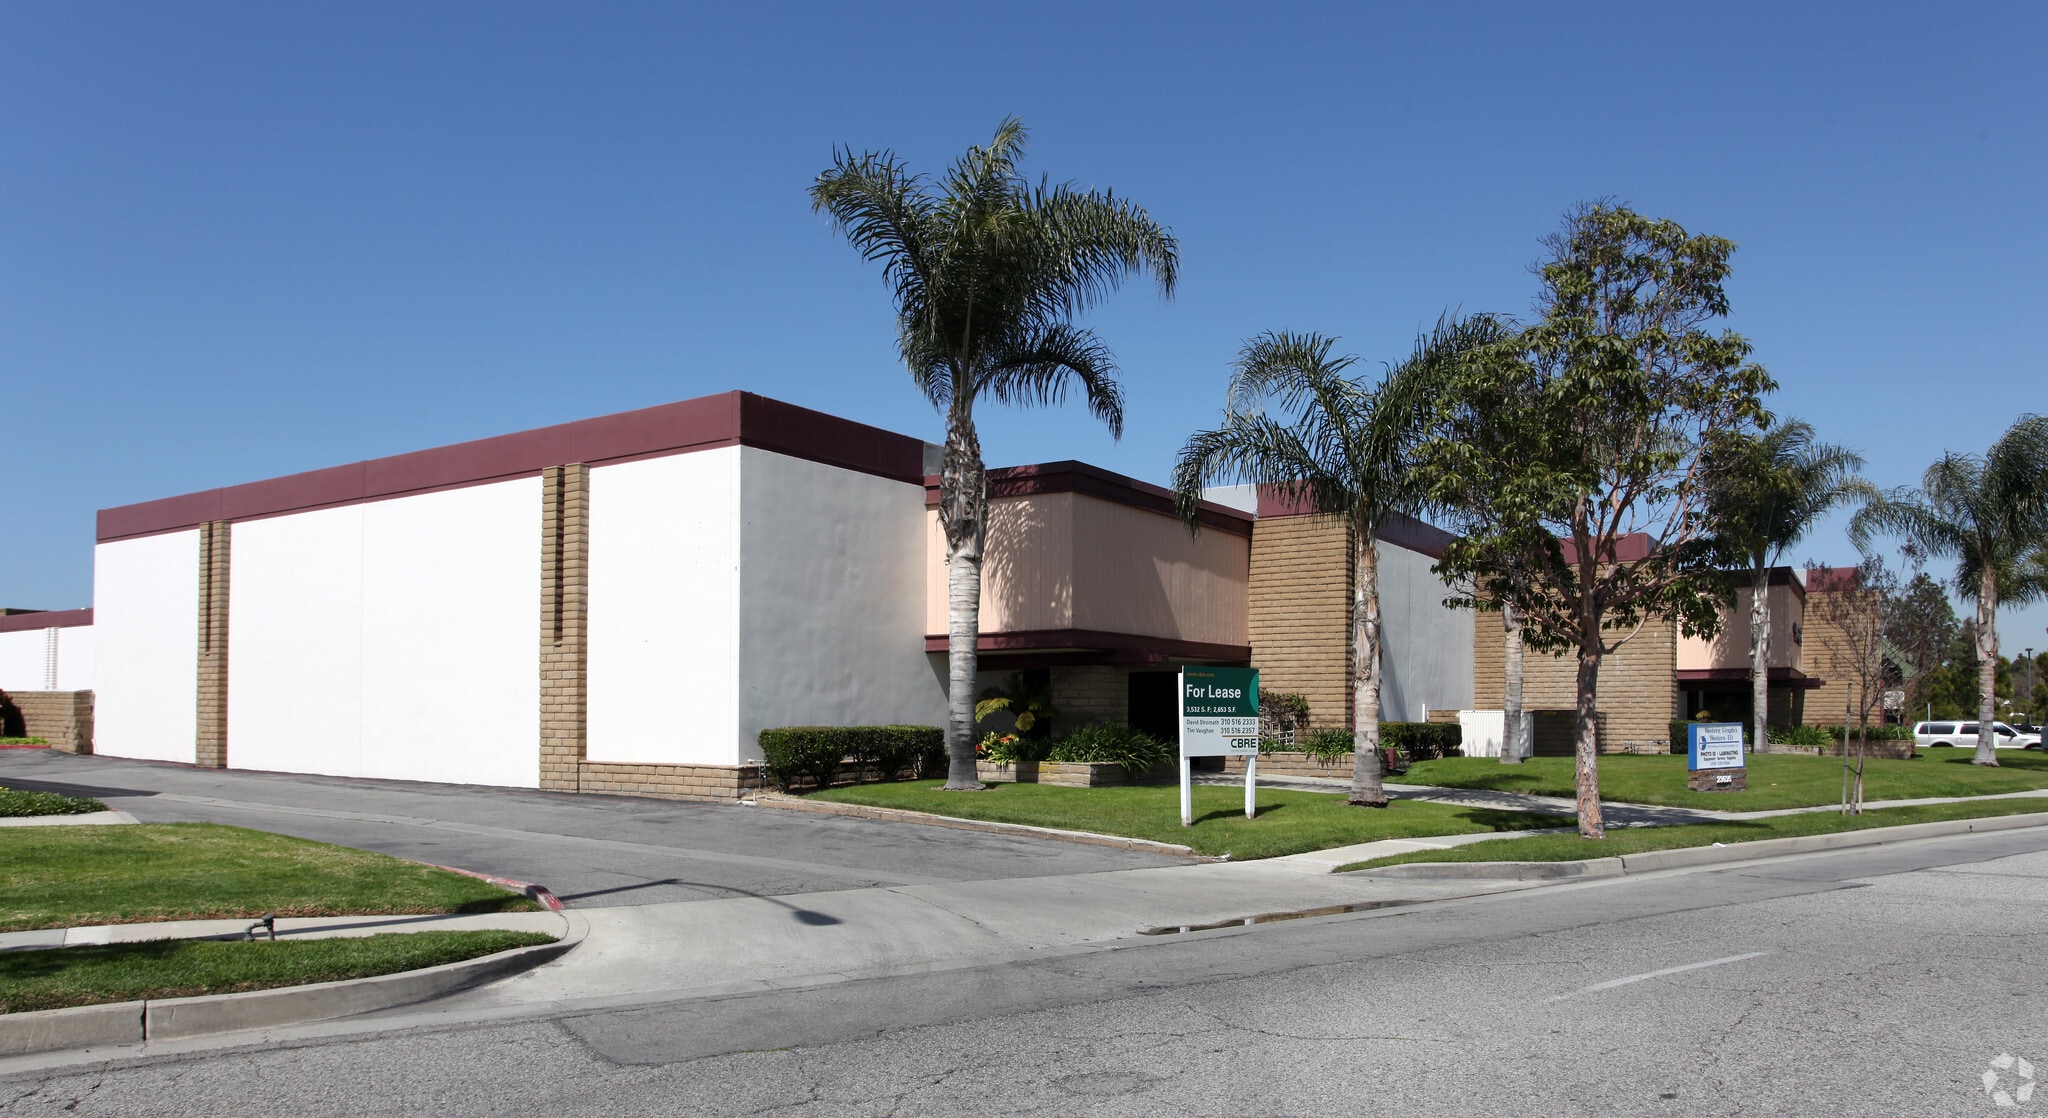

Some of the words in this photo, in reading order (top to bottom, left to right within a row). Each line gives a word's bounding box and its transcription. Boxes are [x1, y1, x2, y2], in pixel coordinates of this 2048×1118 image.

[1186, 684, 1205, 698] For
[1208, 684, 1241, 698] Lease
[1195, 727, 1214, 735] Vaughan
[1230, 738, 1257, 748] CBRE
